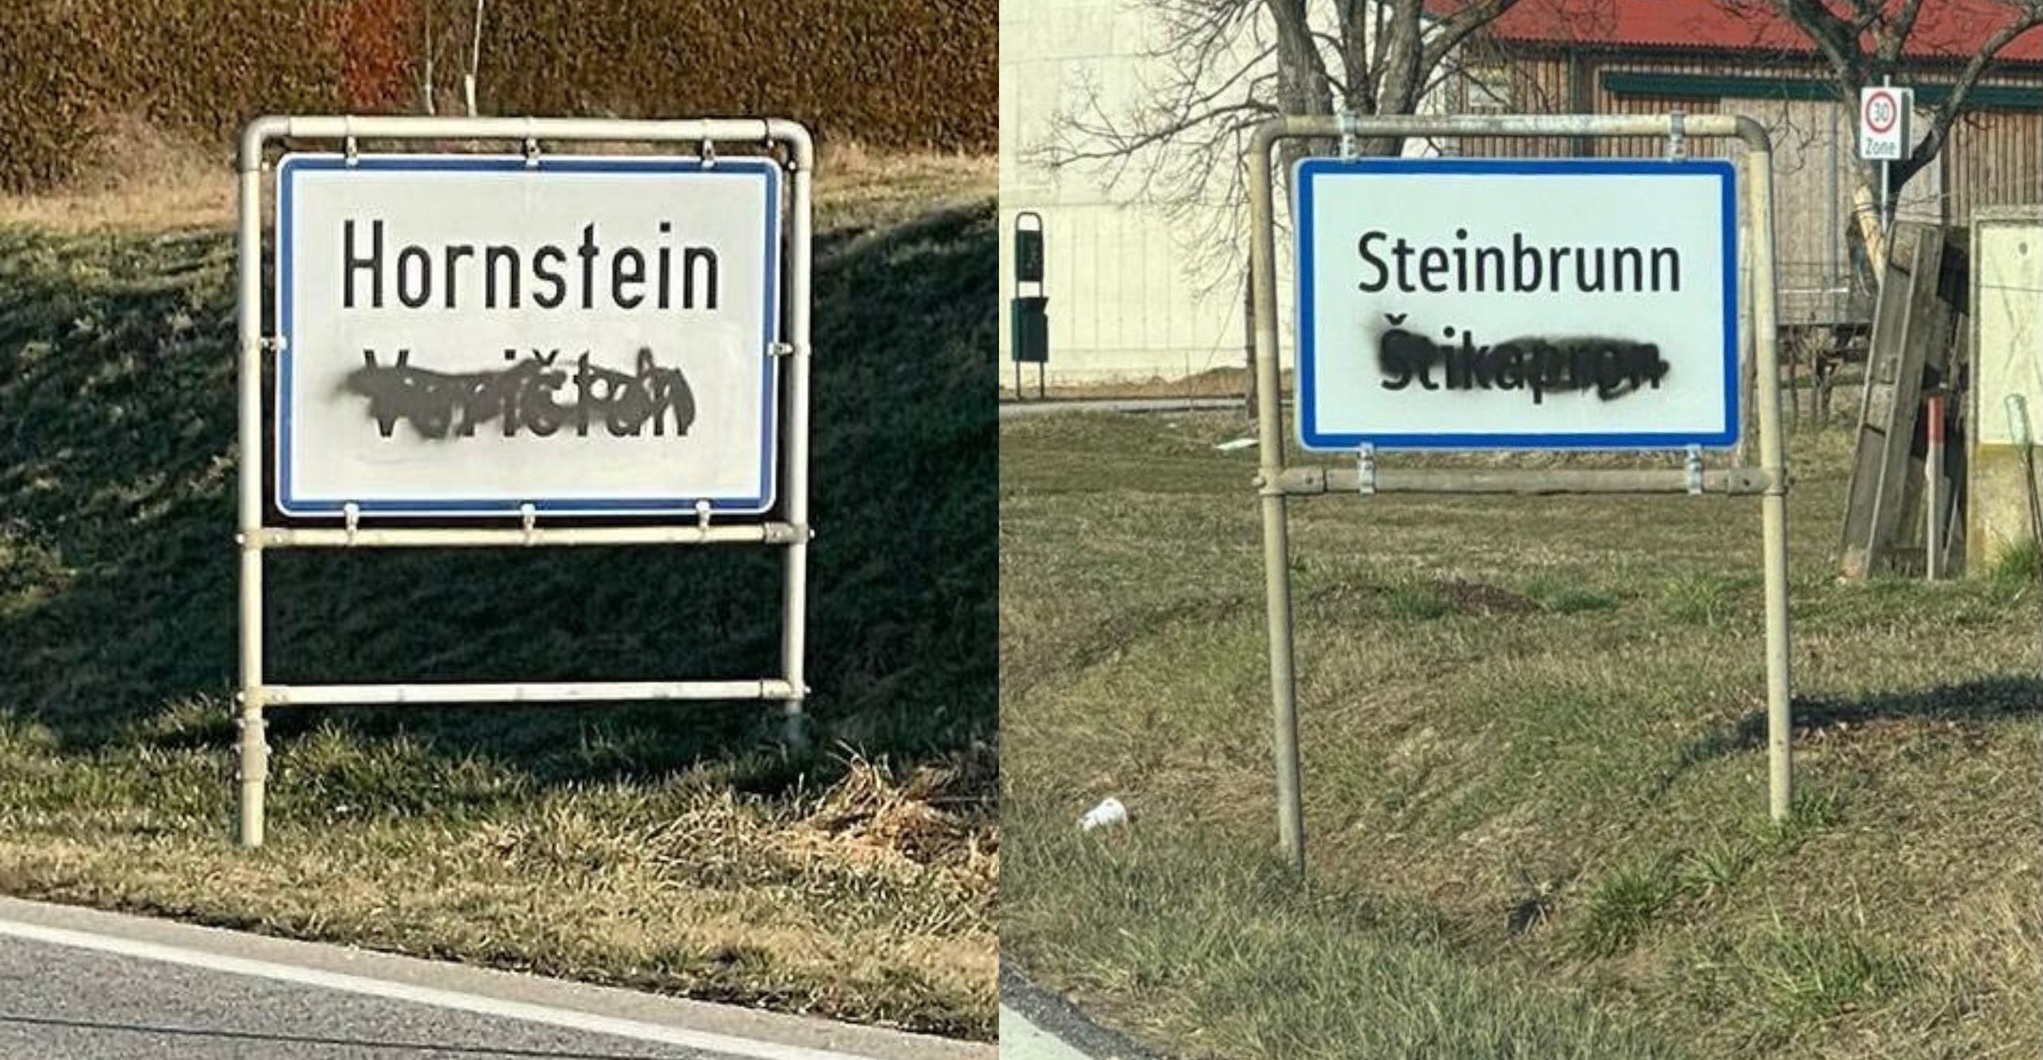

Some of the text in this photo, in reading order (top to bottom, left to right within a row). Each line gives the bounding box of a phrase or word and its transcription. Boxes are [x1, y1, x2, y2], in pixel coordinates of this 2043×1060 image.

[1873, 102, 1889, 123] 30
[1865, 137, 1896, 156] Zone
[343, 219, 719, 309] Hornstein
[1358, 228, 1681, 293] Steinbrunn
